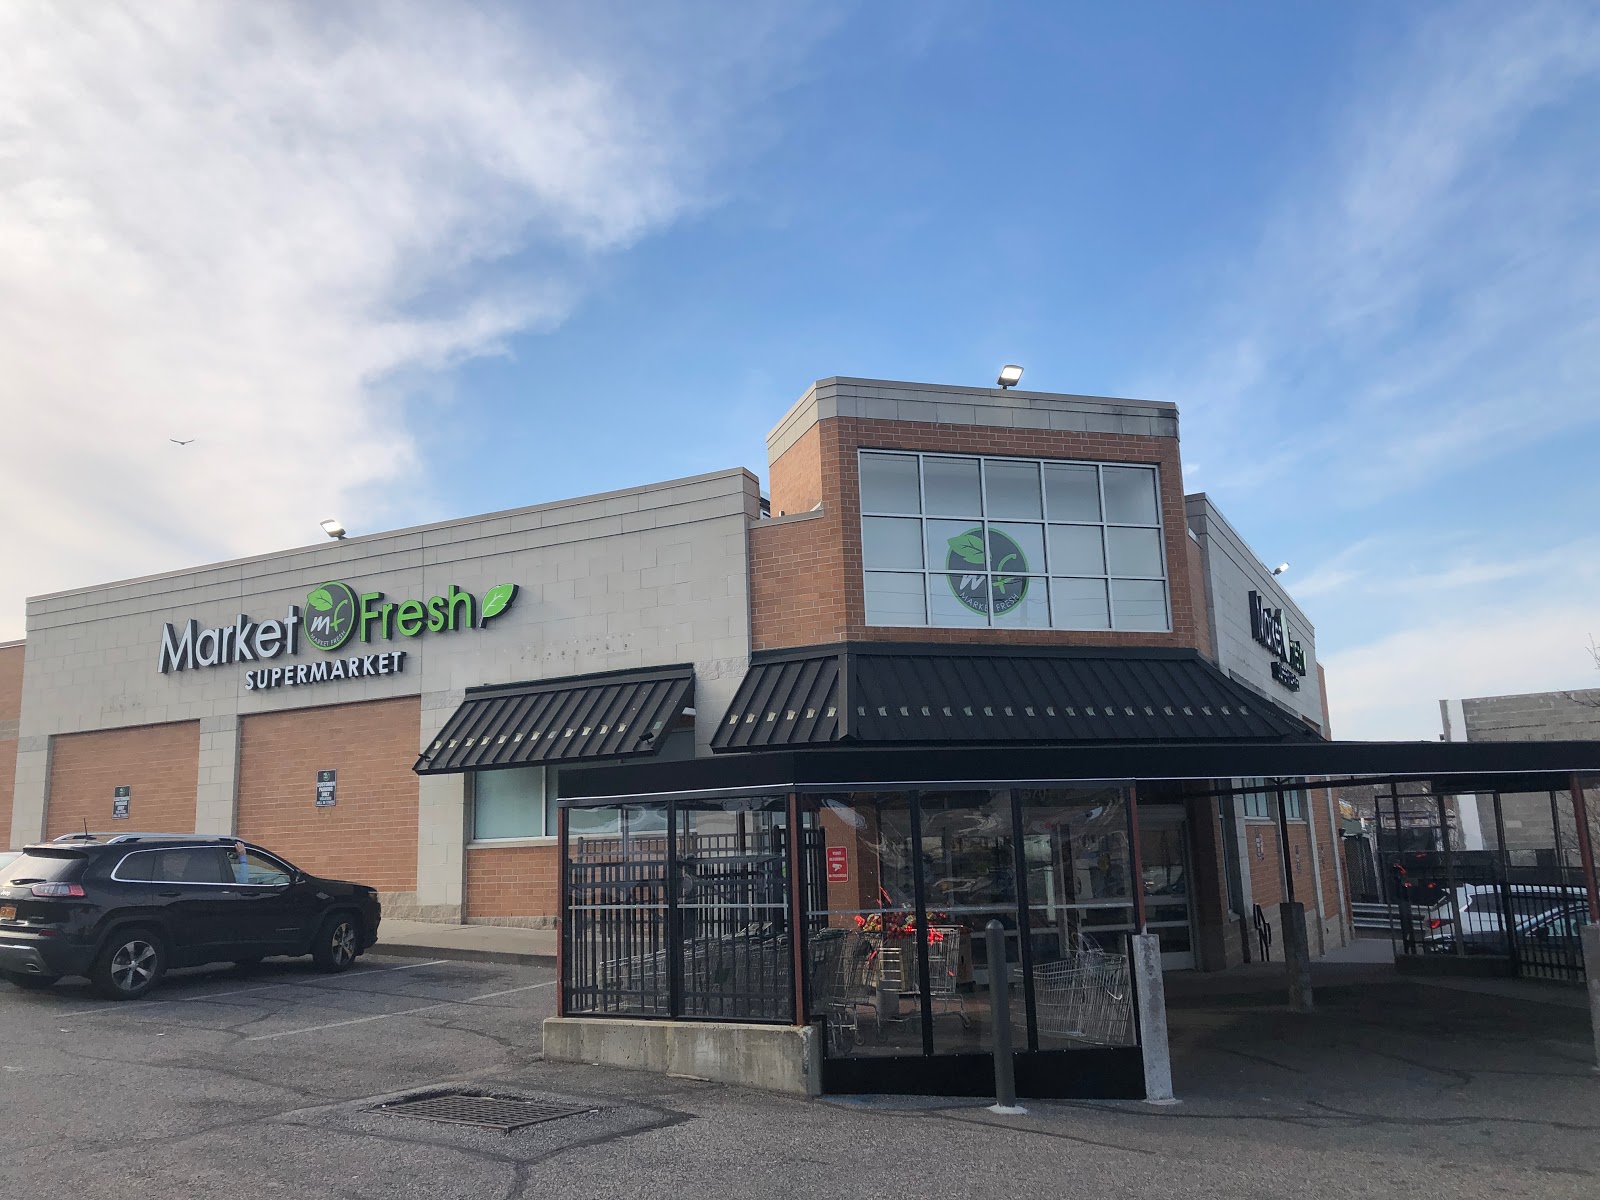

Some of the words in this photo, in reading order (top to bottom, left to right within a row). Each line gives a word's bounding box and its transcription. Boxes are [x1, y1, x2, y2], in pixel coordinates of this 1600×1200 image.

[959, 592, 993, 612] MARKE
[995, 593, 1020, 611] FRESH
[157, 604, 299, 674] Market
[360, 585, 476, 643] Fresh
[310, 633, 330, 647] MARKET
[244, 651, 404, 691] SUPERMARKET
